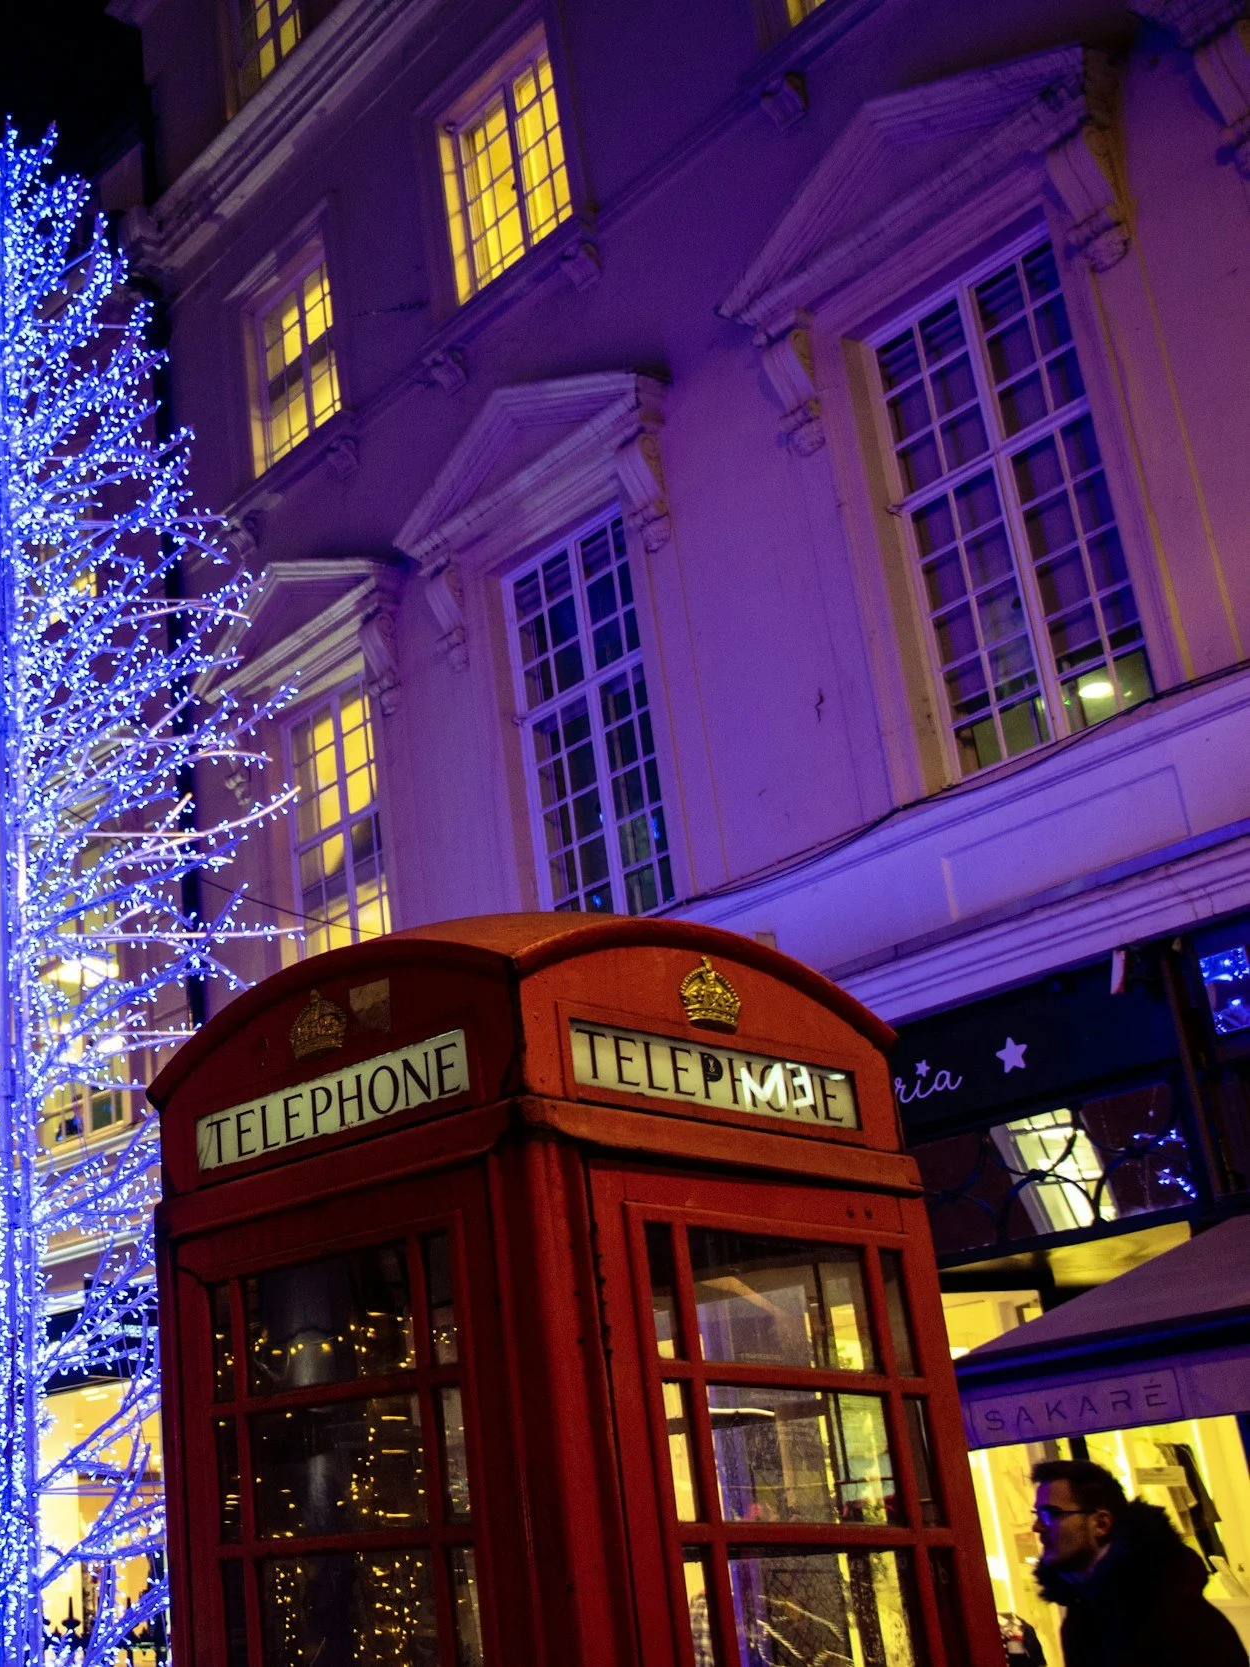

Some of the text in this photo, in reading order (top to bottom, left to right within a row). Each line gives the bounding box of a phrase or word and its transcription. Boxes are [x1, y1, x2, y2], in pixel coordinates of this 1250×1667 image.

[206, 1042, 461, 1164] TELEPHONE
[576, 1029, 844, 1123] TELEPHONE
[985, 1380, 1167, 1431] SAKARÉ
